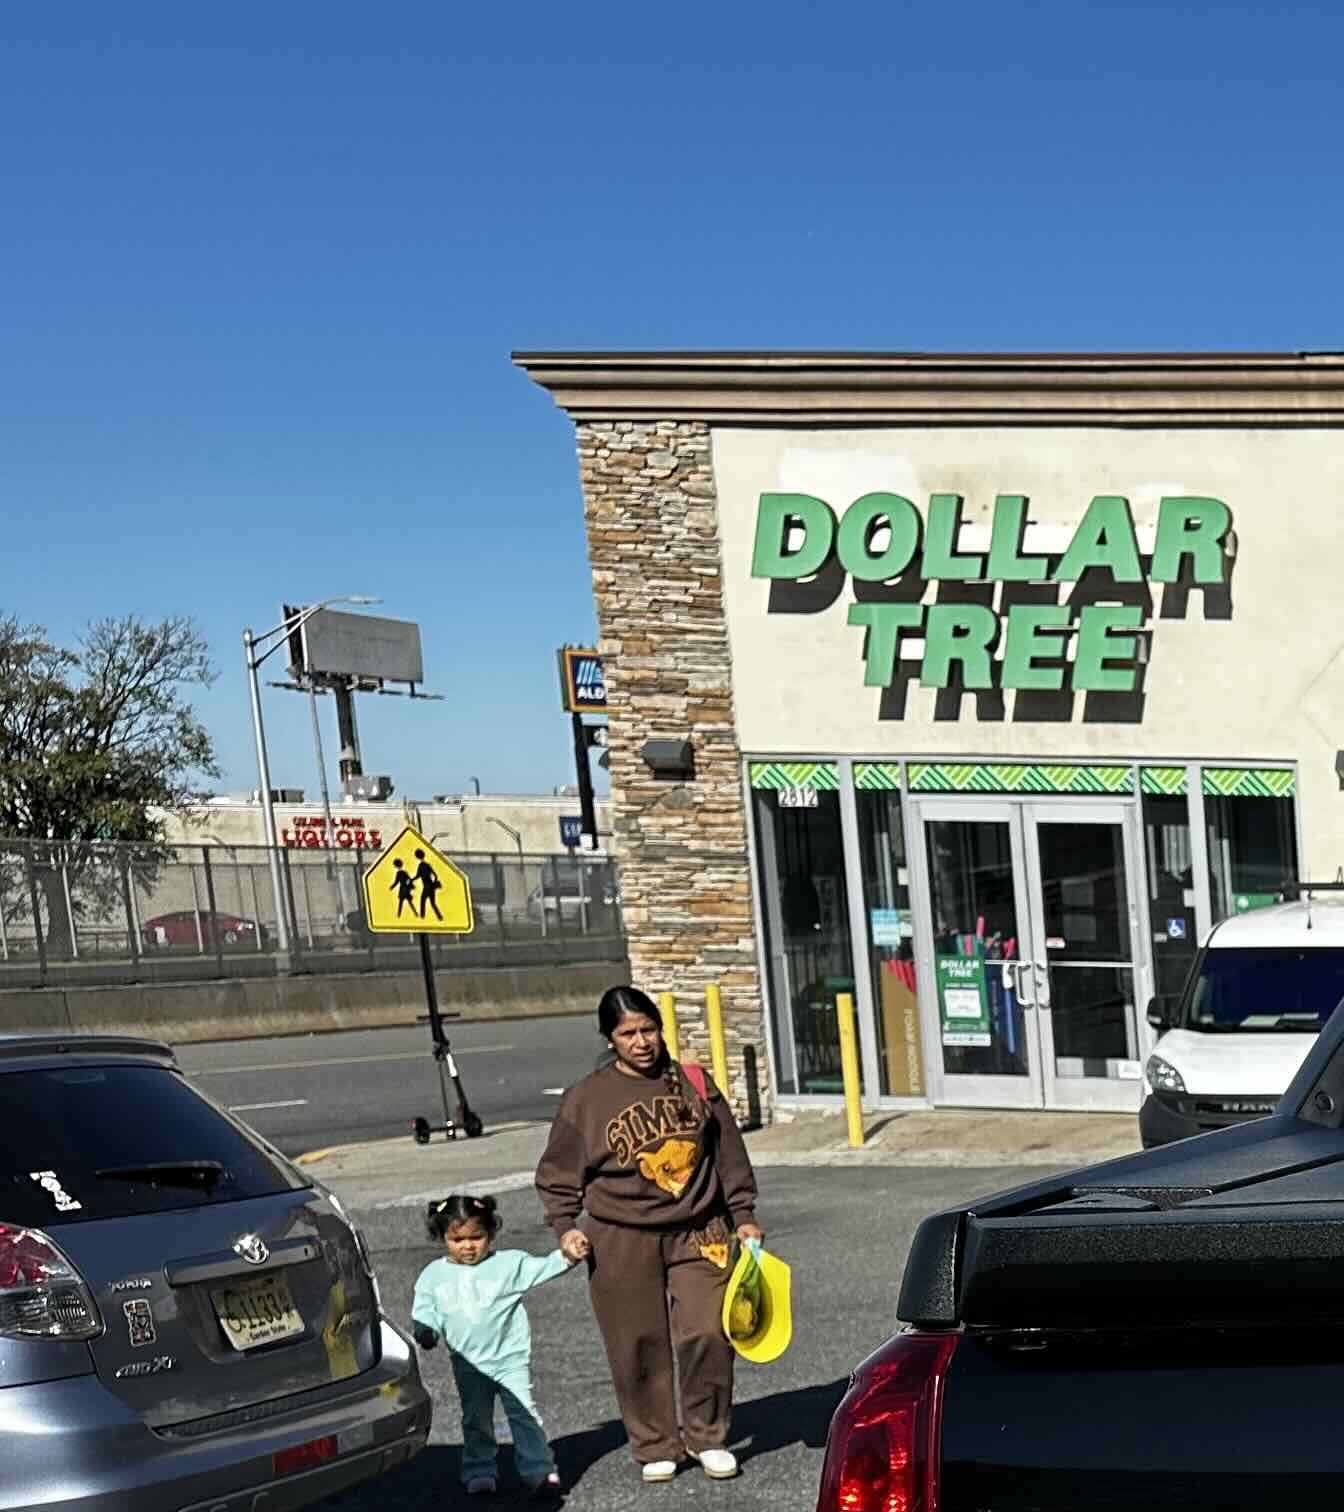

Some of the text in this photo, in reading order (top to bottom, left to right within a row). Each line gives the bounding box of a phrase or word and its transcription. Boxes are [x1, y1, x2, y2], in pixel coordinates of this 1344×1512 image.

[751, 491, 1236, 583] DOLLAR
[847, 602, 1147, 692] TREE
[577, 686, 606, 700] ALD
[282, 829, 382, 849] LIQUORS
[941, 959, 980, 970] DOLLAR
